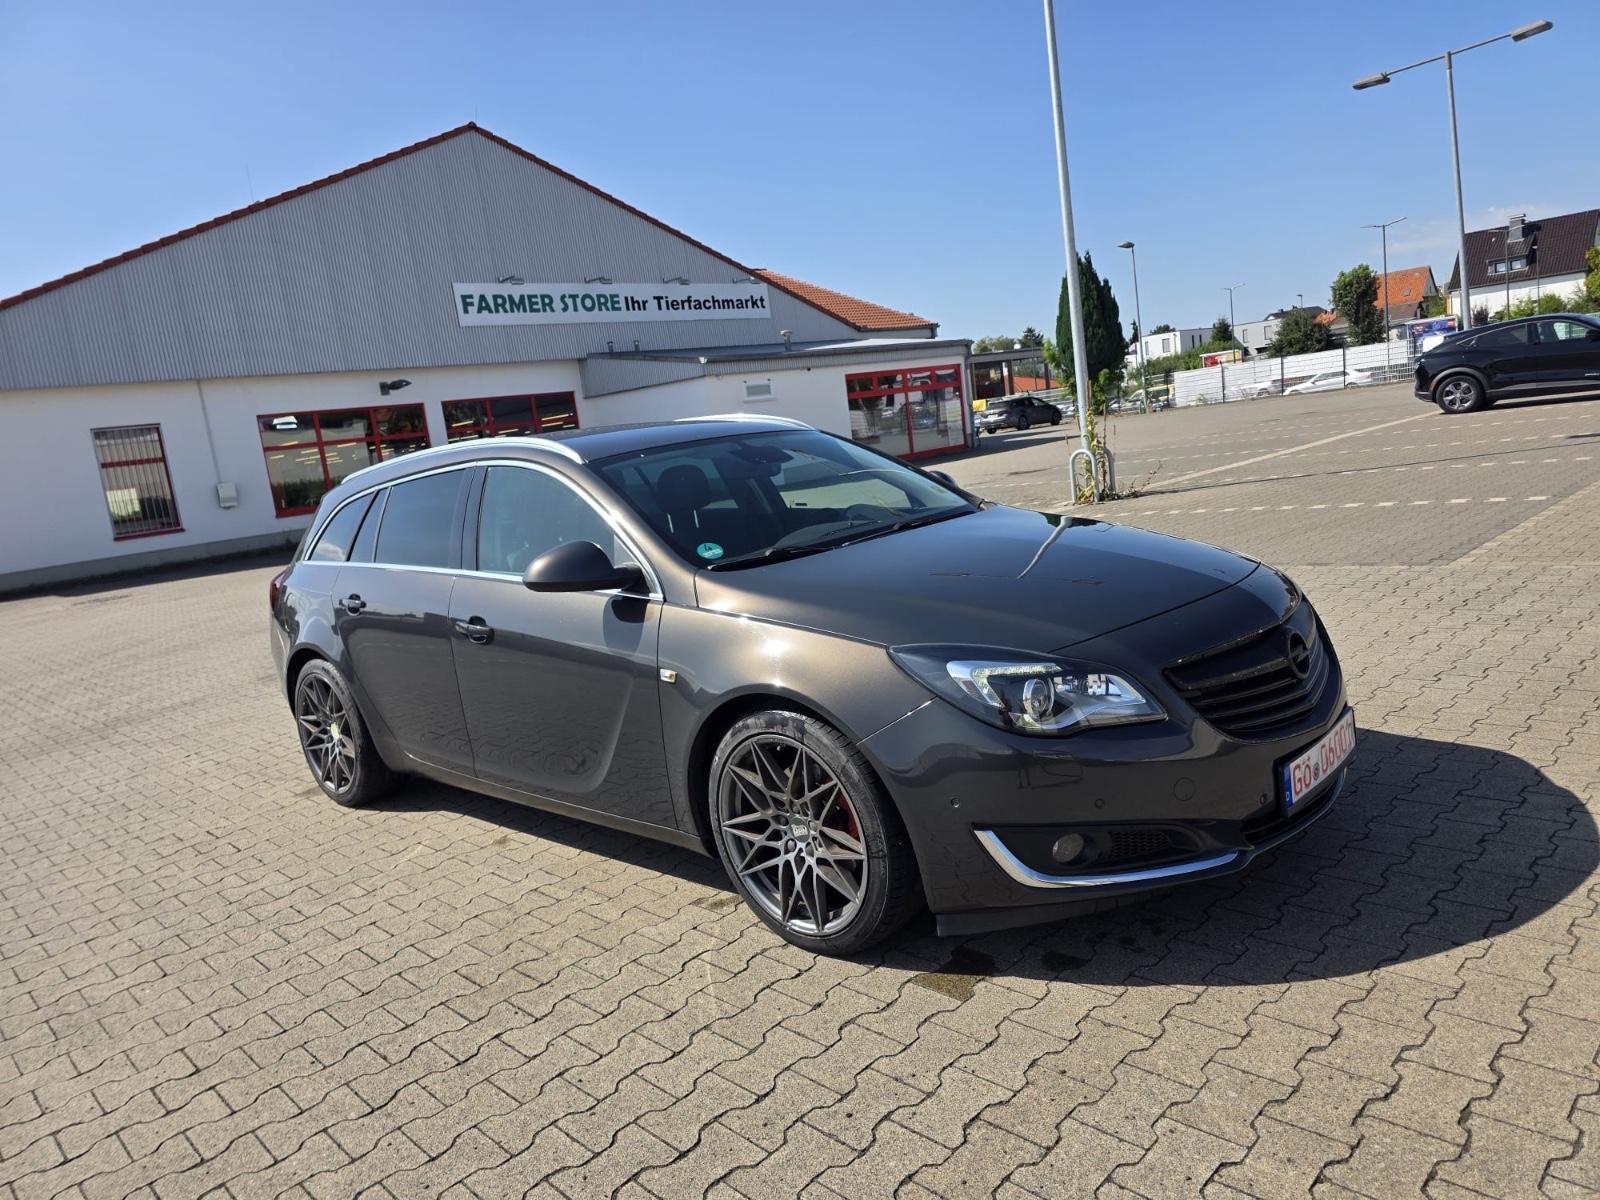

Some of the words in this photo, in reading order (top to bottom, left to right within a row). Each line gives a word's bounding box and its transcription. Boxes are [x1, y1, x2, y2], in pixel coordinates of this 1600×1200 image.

[460, 294, 555, 314] FARMER
[560, 293, 622, 312] STORE
[625, 296, 649, 311] Ihr
[653, 295, 766, 311] Tierfachmarkt
